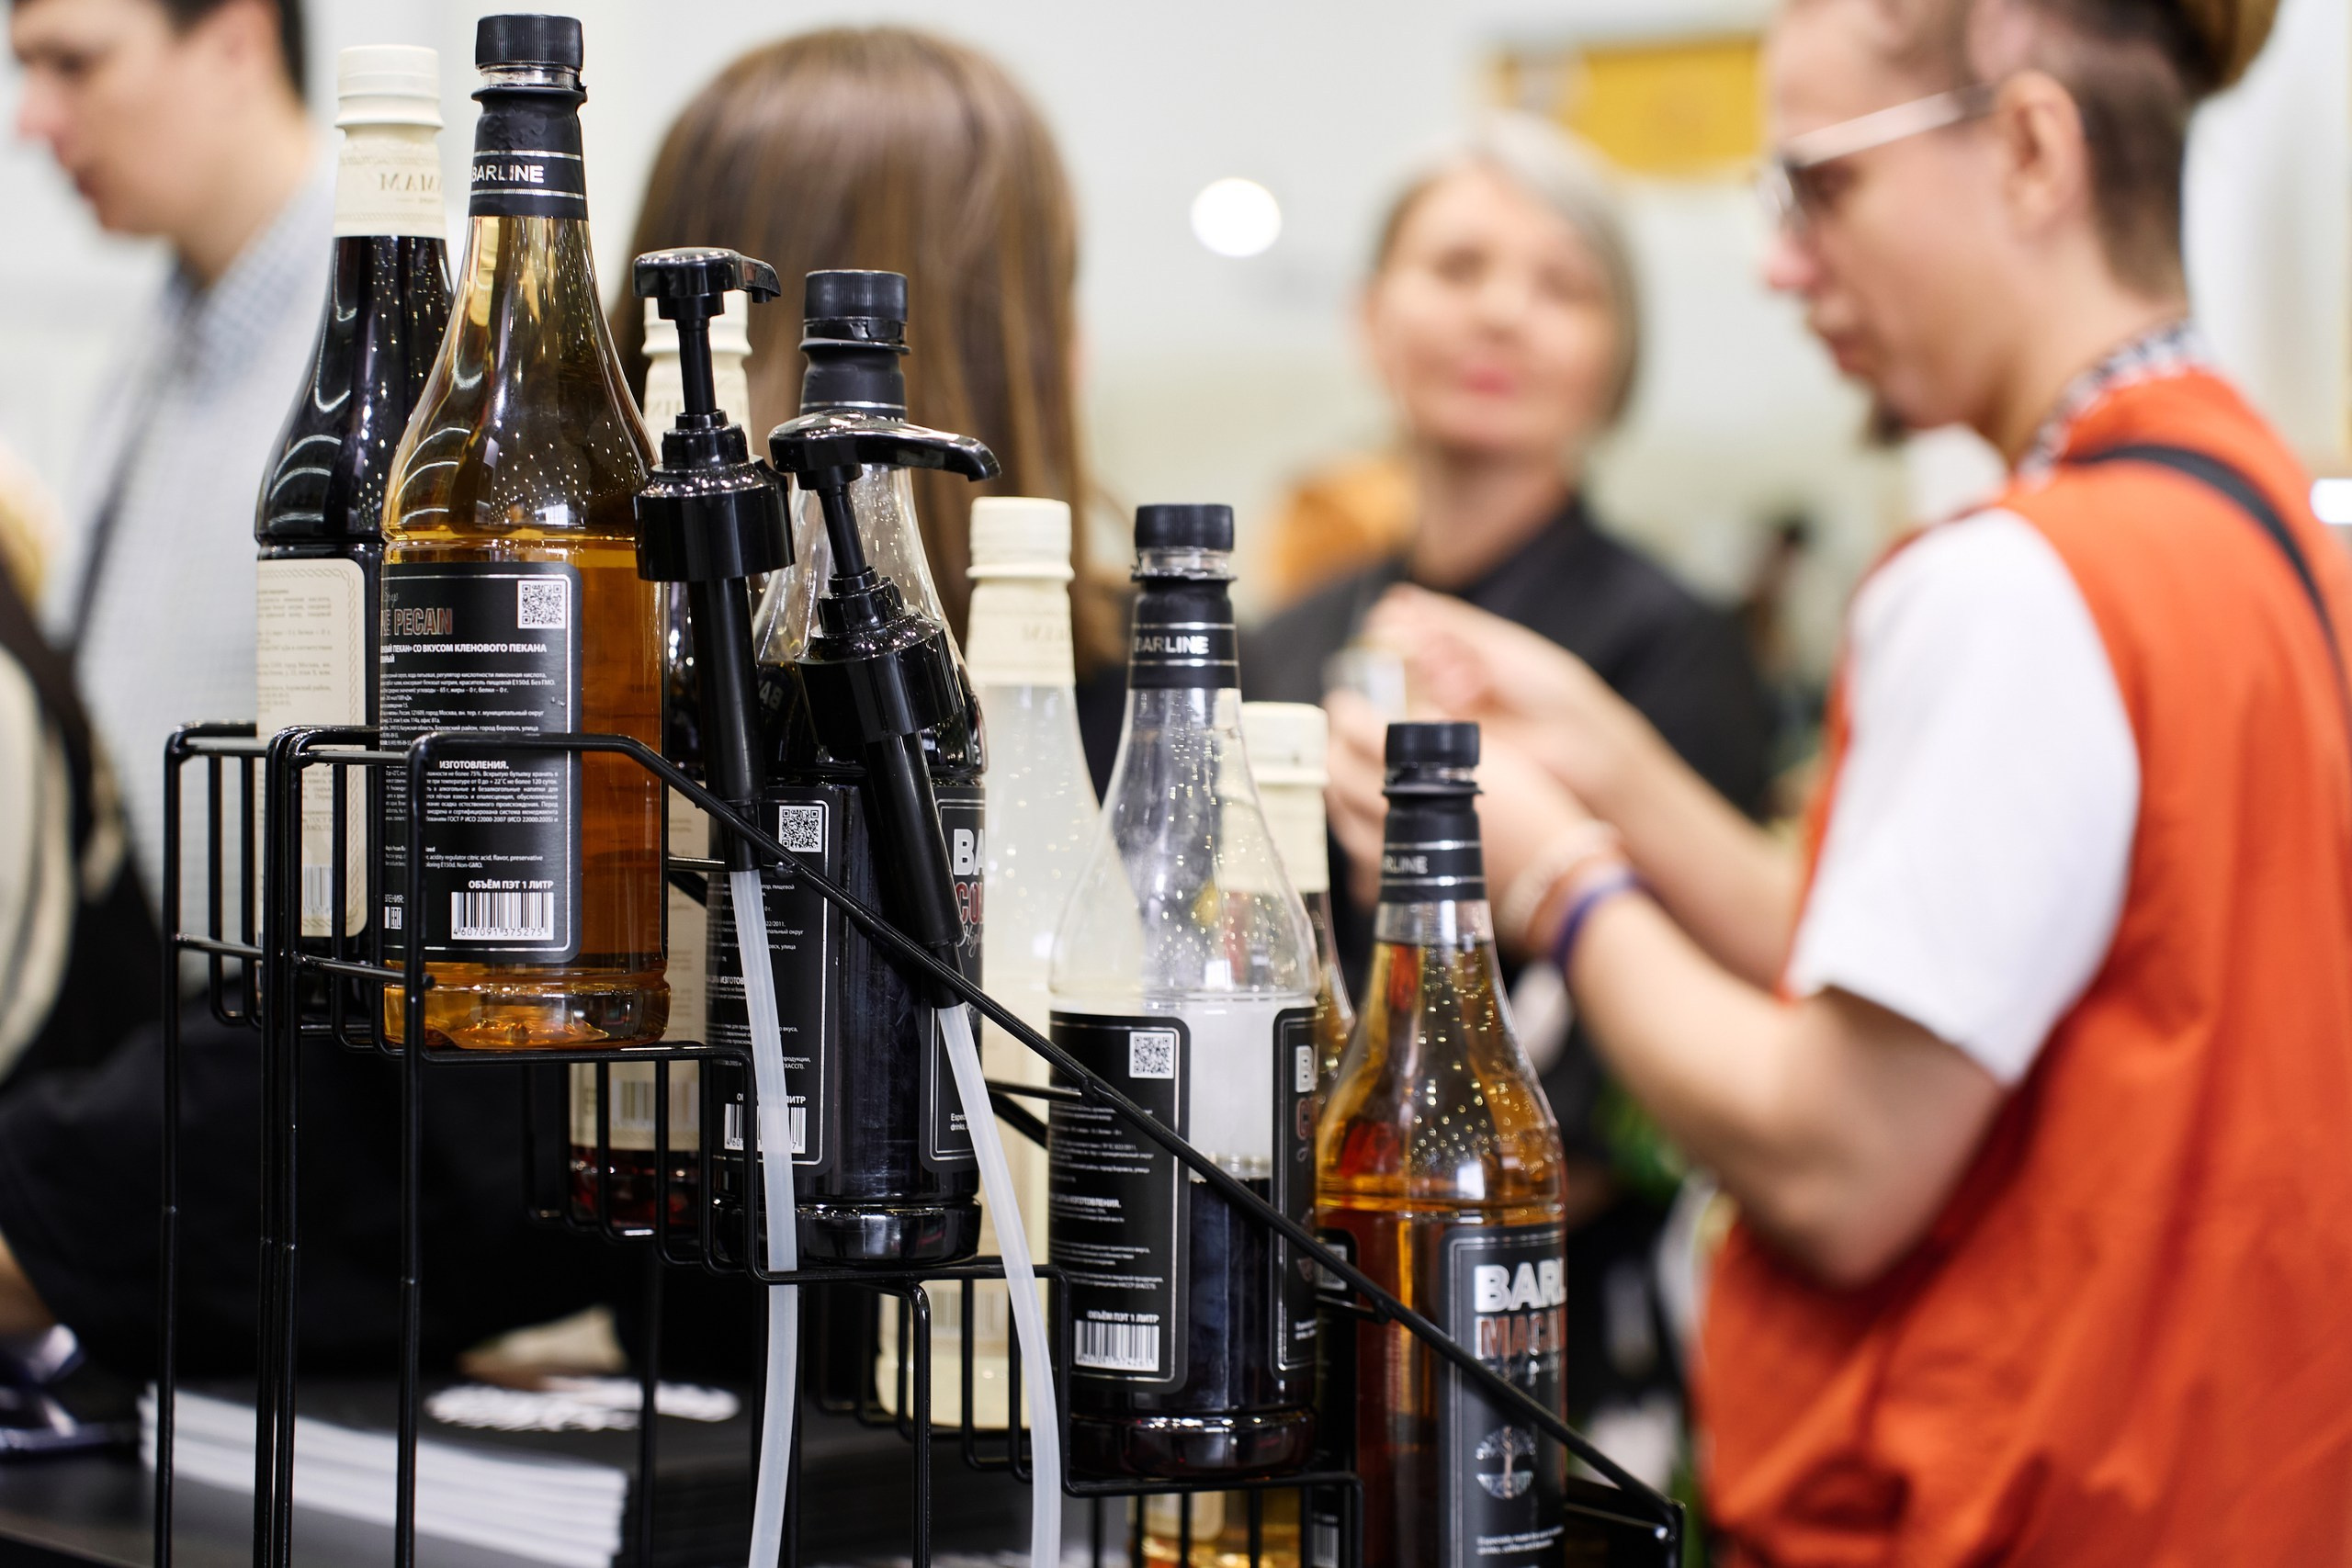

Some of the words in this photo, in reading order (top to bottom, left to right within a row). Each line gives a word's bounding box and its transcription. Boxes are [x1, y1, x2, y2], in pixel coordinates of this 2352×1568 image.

[471, 164, 545, 184] BARLINE
[394, 607, 453, 636] PECAN
[413, 644, 422, 653] СО
[423, 644, 454, 653] ВКУСОМ
[455, 643, 508, 653] КЛЕНОВОГО
[509, 644, 547, 653] ПЕКАНА
[439, 761, 509, 770] ИЗГОТОВЛЕНИЯ.
[445, 854, 467, 863] regulator
[481, 854, 492, 863] acid,
[492, 854, 510, 863] flavor,
[510, 855, 543, 863] preservative
[468, 878, 501, 889] ОБЪЁМ
[502, 879, 520, 889] ПЭТ
[522, 880, 526, 889] 1
[528, 880, 554, 889] ЛИТР
[453, 927, 458, 935] 4
[461, 928, 499, 937] 607091
[503, 928, 544, 937] 375275
[788, 929, 804, 937] округ
[719, 976, 745, 986] ИЗГОТОВ
